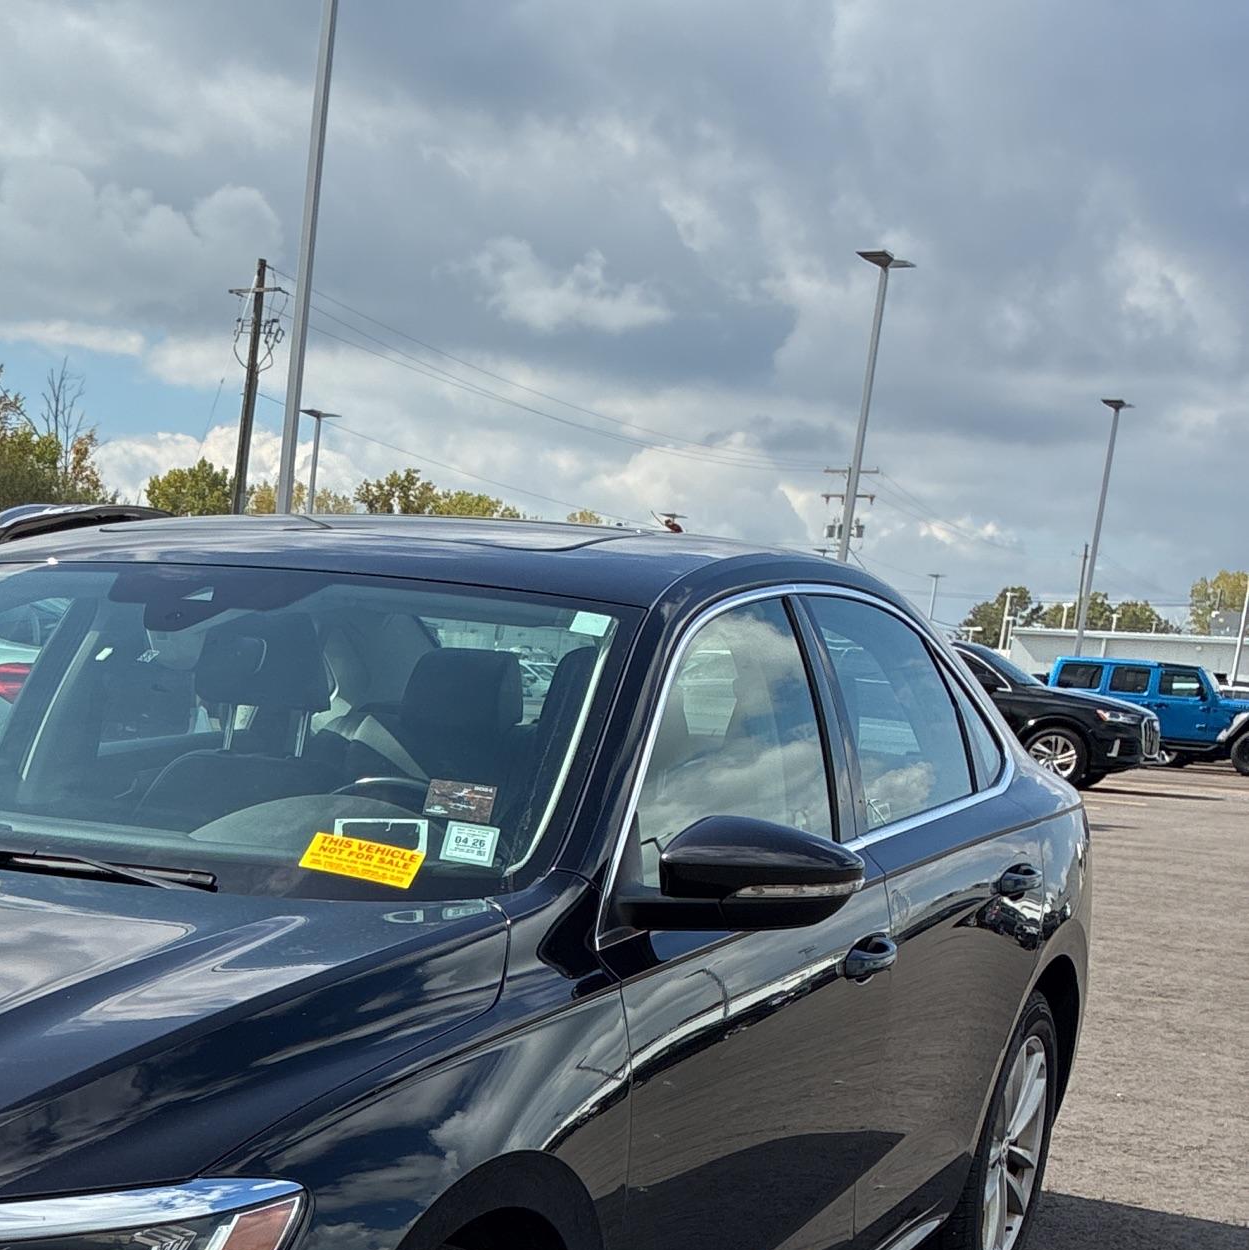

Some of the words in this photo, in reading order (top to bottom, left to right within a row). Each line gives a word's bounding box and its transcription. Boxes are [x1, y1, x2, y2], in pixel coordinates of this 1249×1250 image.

[320, 835, 353, 849] THIS
[357, 842, 420, 863] VEHICLE
[454, 835, 469, 845] 04
[318, 845, 345, 856] NOT
[347, 850, 373, 862] FOR
[376, 856, 412, 870] SALE
